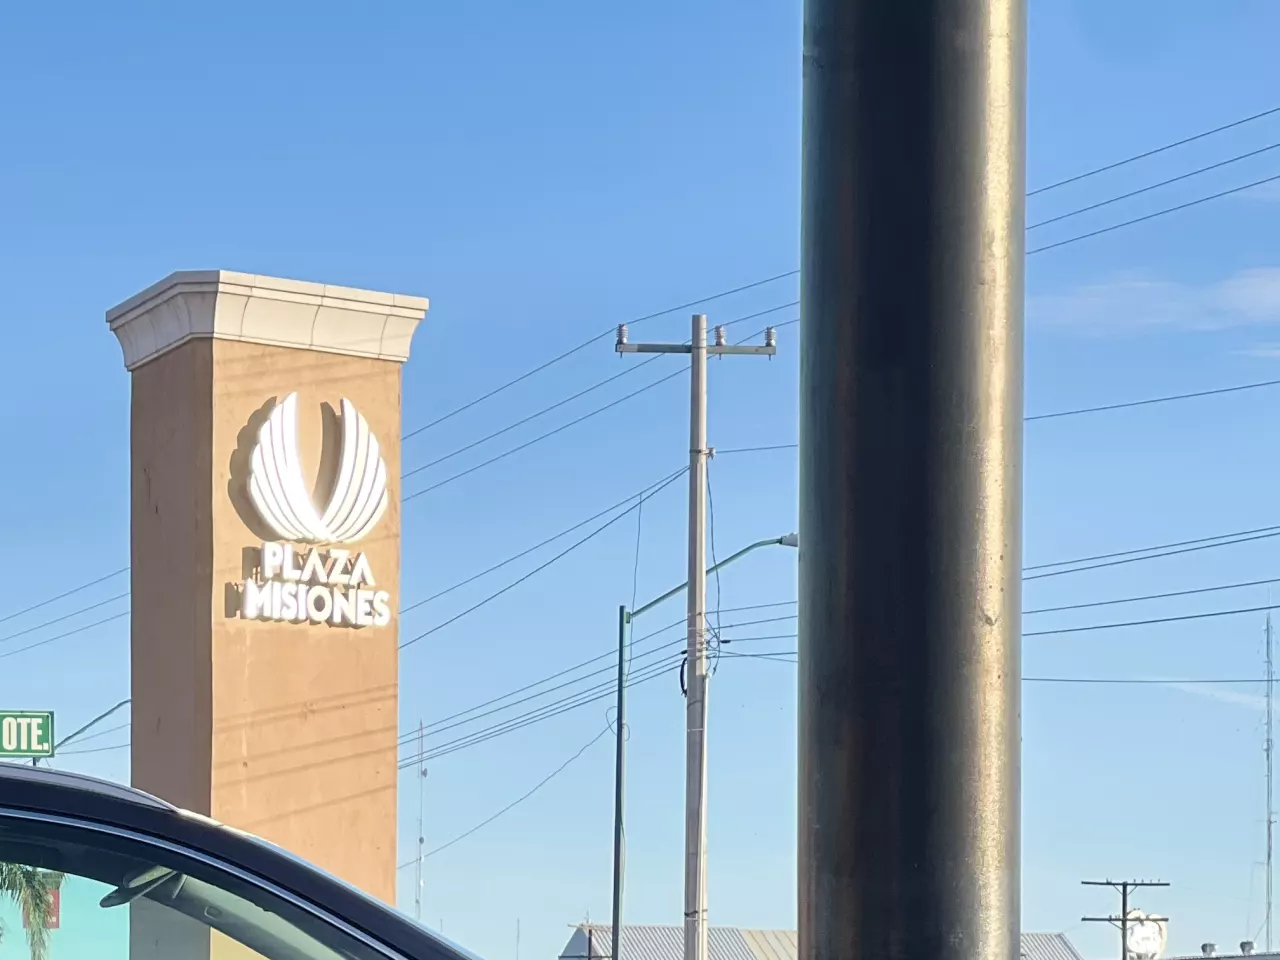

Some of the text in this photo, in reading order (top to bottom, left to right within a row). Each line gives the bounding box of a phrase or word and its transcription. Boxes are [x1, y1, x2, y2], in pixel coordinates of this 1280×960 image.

[261, 541, 377, 587] PLAZA
[244, 577, 391, 627] MISIONES
[2, 716, 50, 751] OTE.
